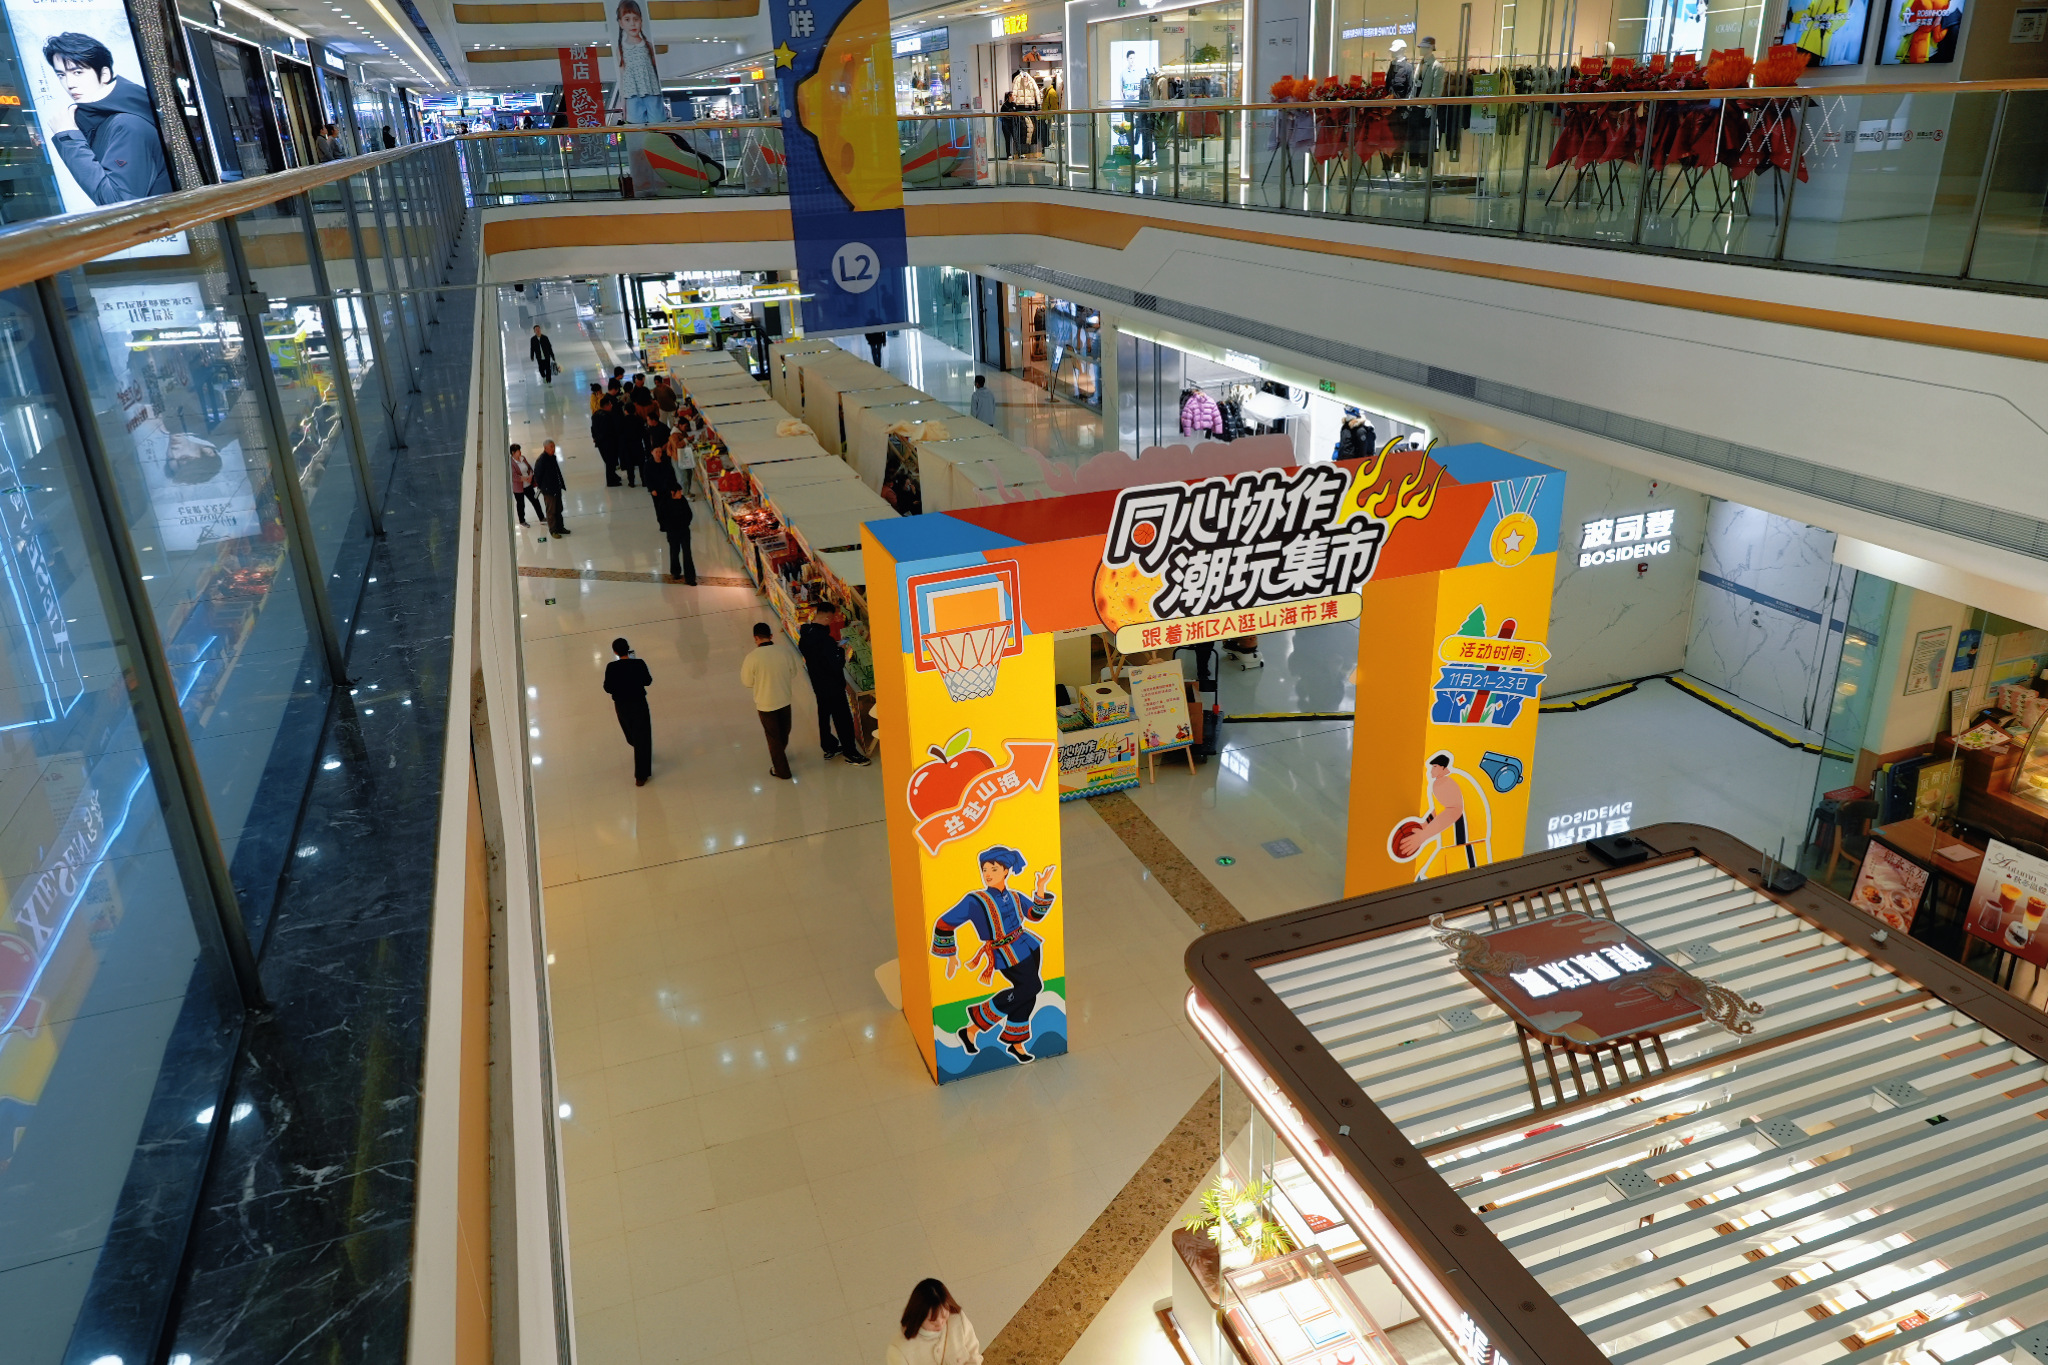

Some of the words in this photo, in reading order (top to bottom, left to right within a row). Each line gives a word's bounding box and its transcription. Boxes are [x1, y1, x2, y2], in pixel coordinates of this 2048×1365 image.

[788, 0, 815, 37] 烊
[838, 255, 873, 282] L2
[1110, 467, 1345, 569] 同心协作
[1581, 508, 1675, 550] 波司登
[1157, 520, 1382, 619] 潮玩集市
[1580, 540, 1671, 568] BOSIDENG
[1448, 673, 1528, 691] 11月21-23日
[943, 770, 1021, 836] 共赴山海
